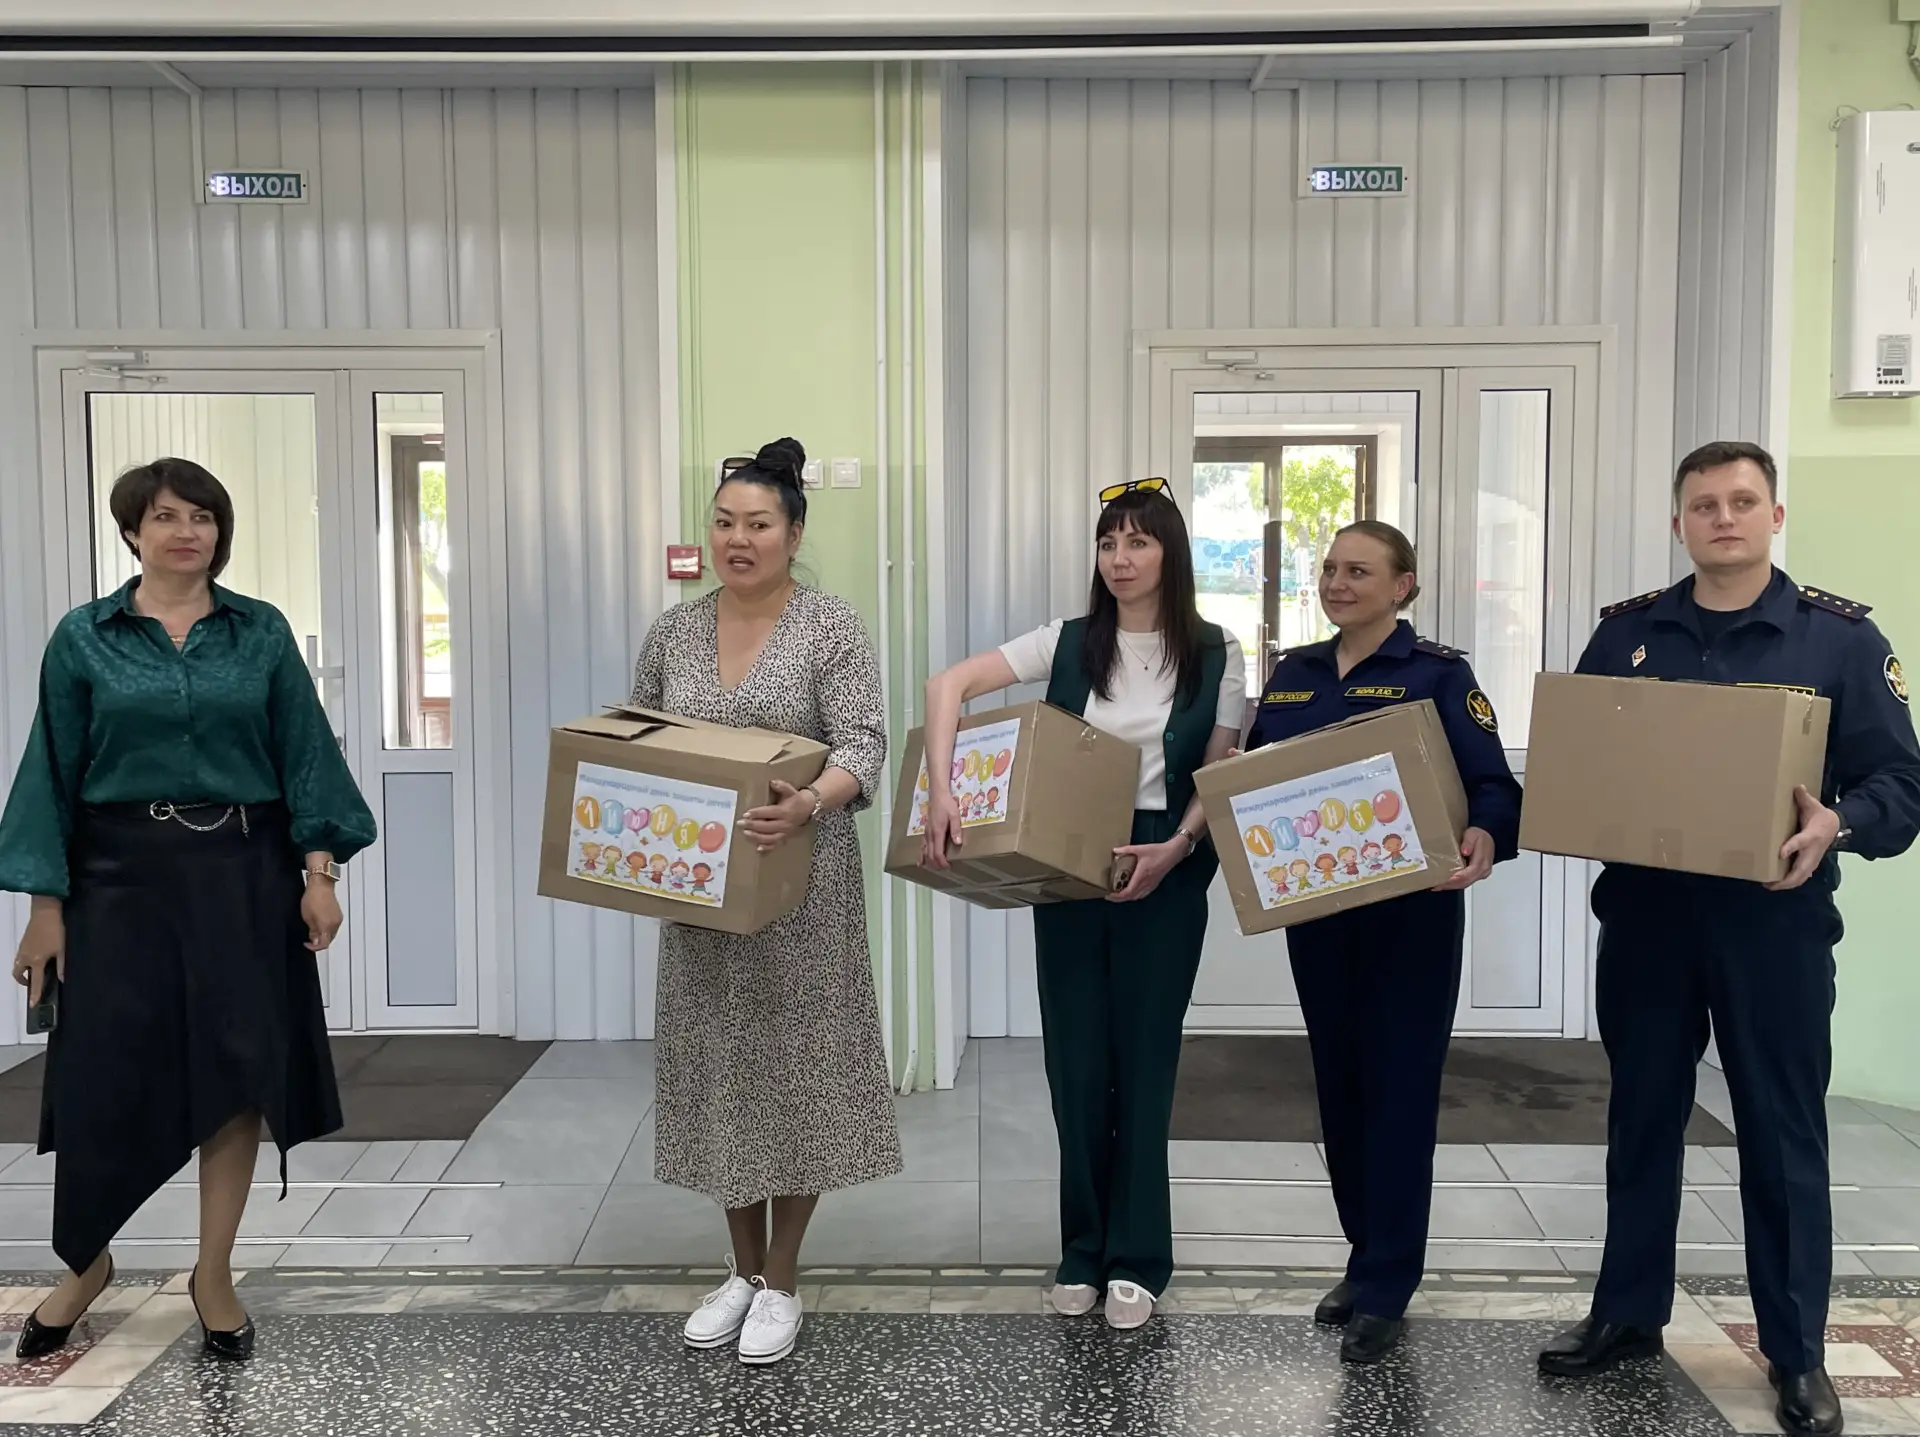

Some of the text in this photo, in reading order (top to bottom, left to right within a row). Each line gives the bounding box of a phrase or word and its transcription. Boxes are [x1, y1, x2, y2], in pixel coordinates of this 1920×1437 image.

[216, 176, 298, 197] ВЫХОД
[1316, 170, 1398, 190] ВЫХОД
[584, 800, 595, 828] 1
[1254, 828, 1271, 854] 1
